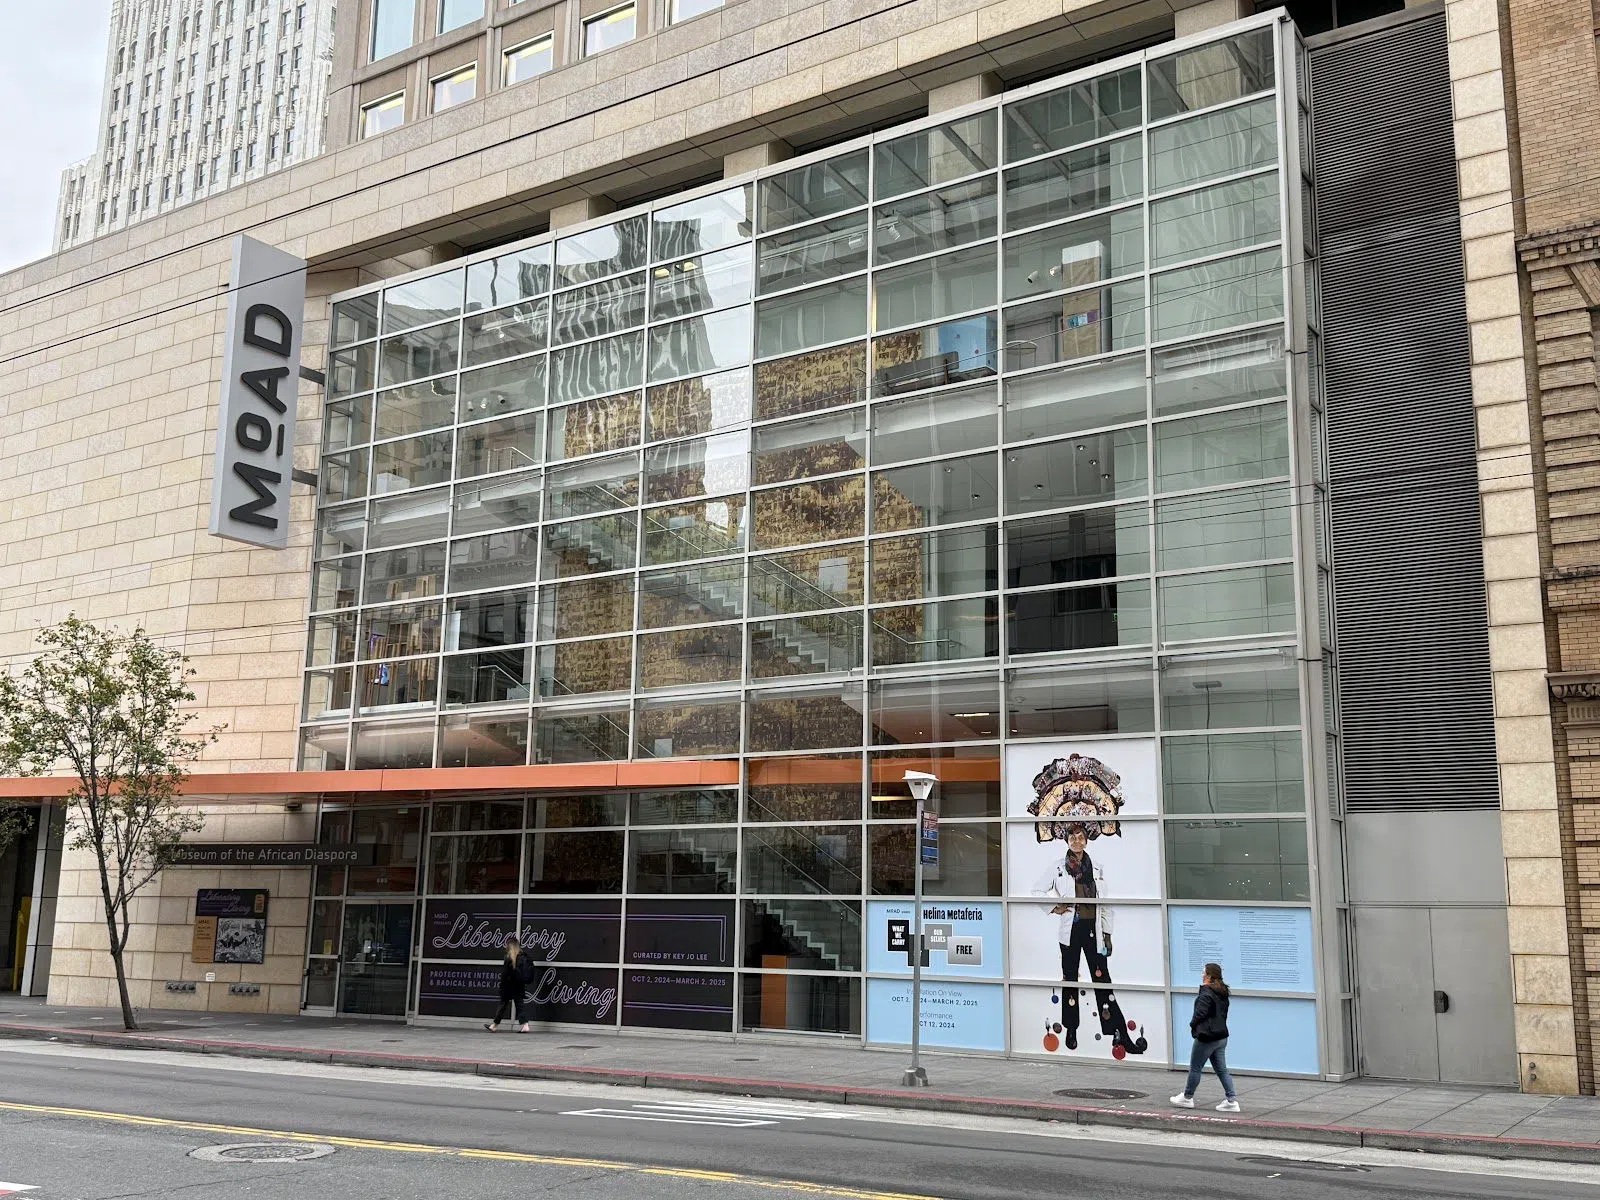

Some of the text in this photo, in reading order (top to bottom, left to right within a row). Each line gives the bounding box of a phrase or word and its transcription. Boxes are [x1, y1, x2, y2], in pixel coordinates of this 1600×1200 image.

[220, 849, 232, 860] of
[236, 849, 254, 860] the
[258, 849, 300, 860] African
[305, 849, 358, 862] Diaspora
[923, 907, 983, 921] Helina Metaferia
[956, 945, 973, 955] FREE
[633, 951, 662, 959] CURATED
[430, 970, 472, 979] PROTECTIVE
[436, 980, 466, 988] RADICAL
[647, 976, 653, 984] 2,
[523, 967, 617, 1019] Living
[919, 1010, 953, 1020] erformance
[938, 1021, 955, 1029] 2024
